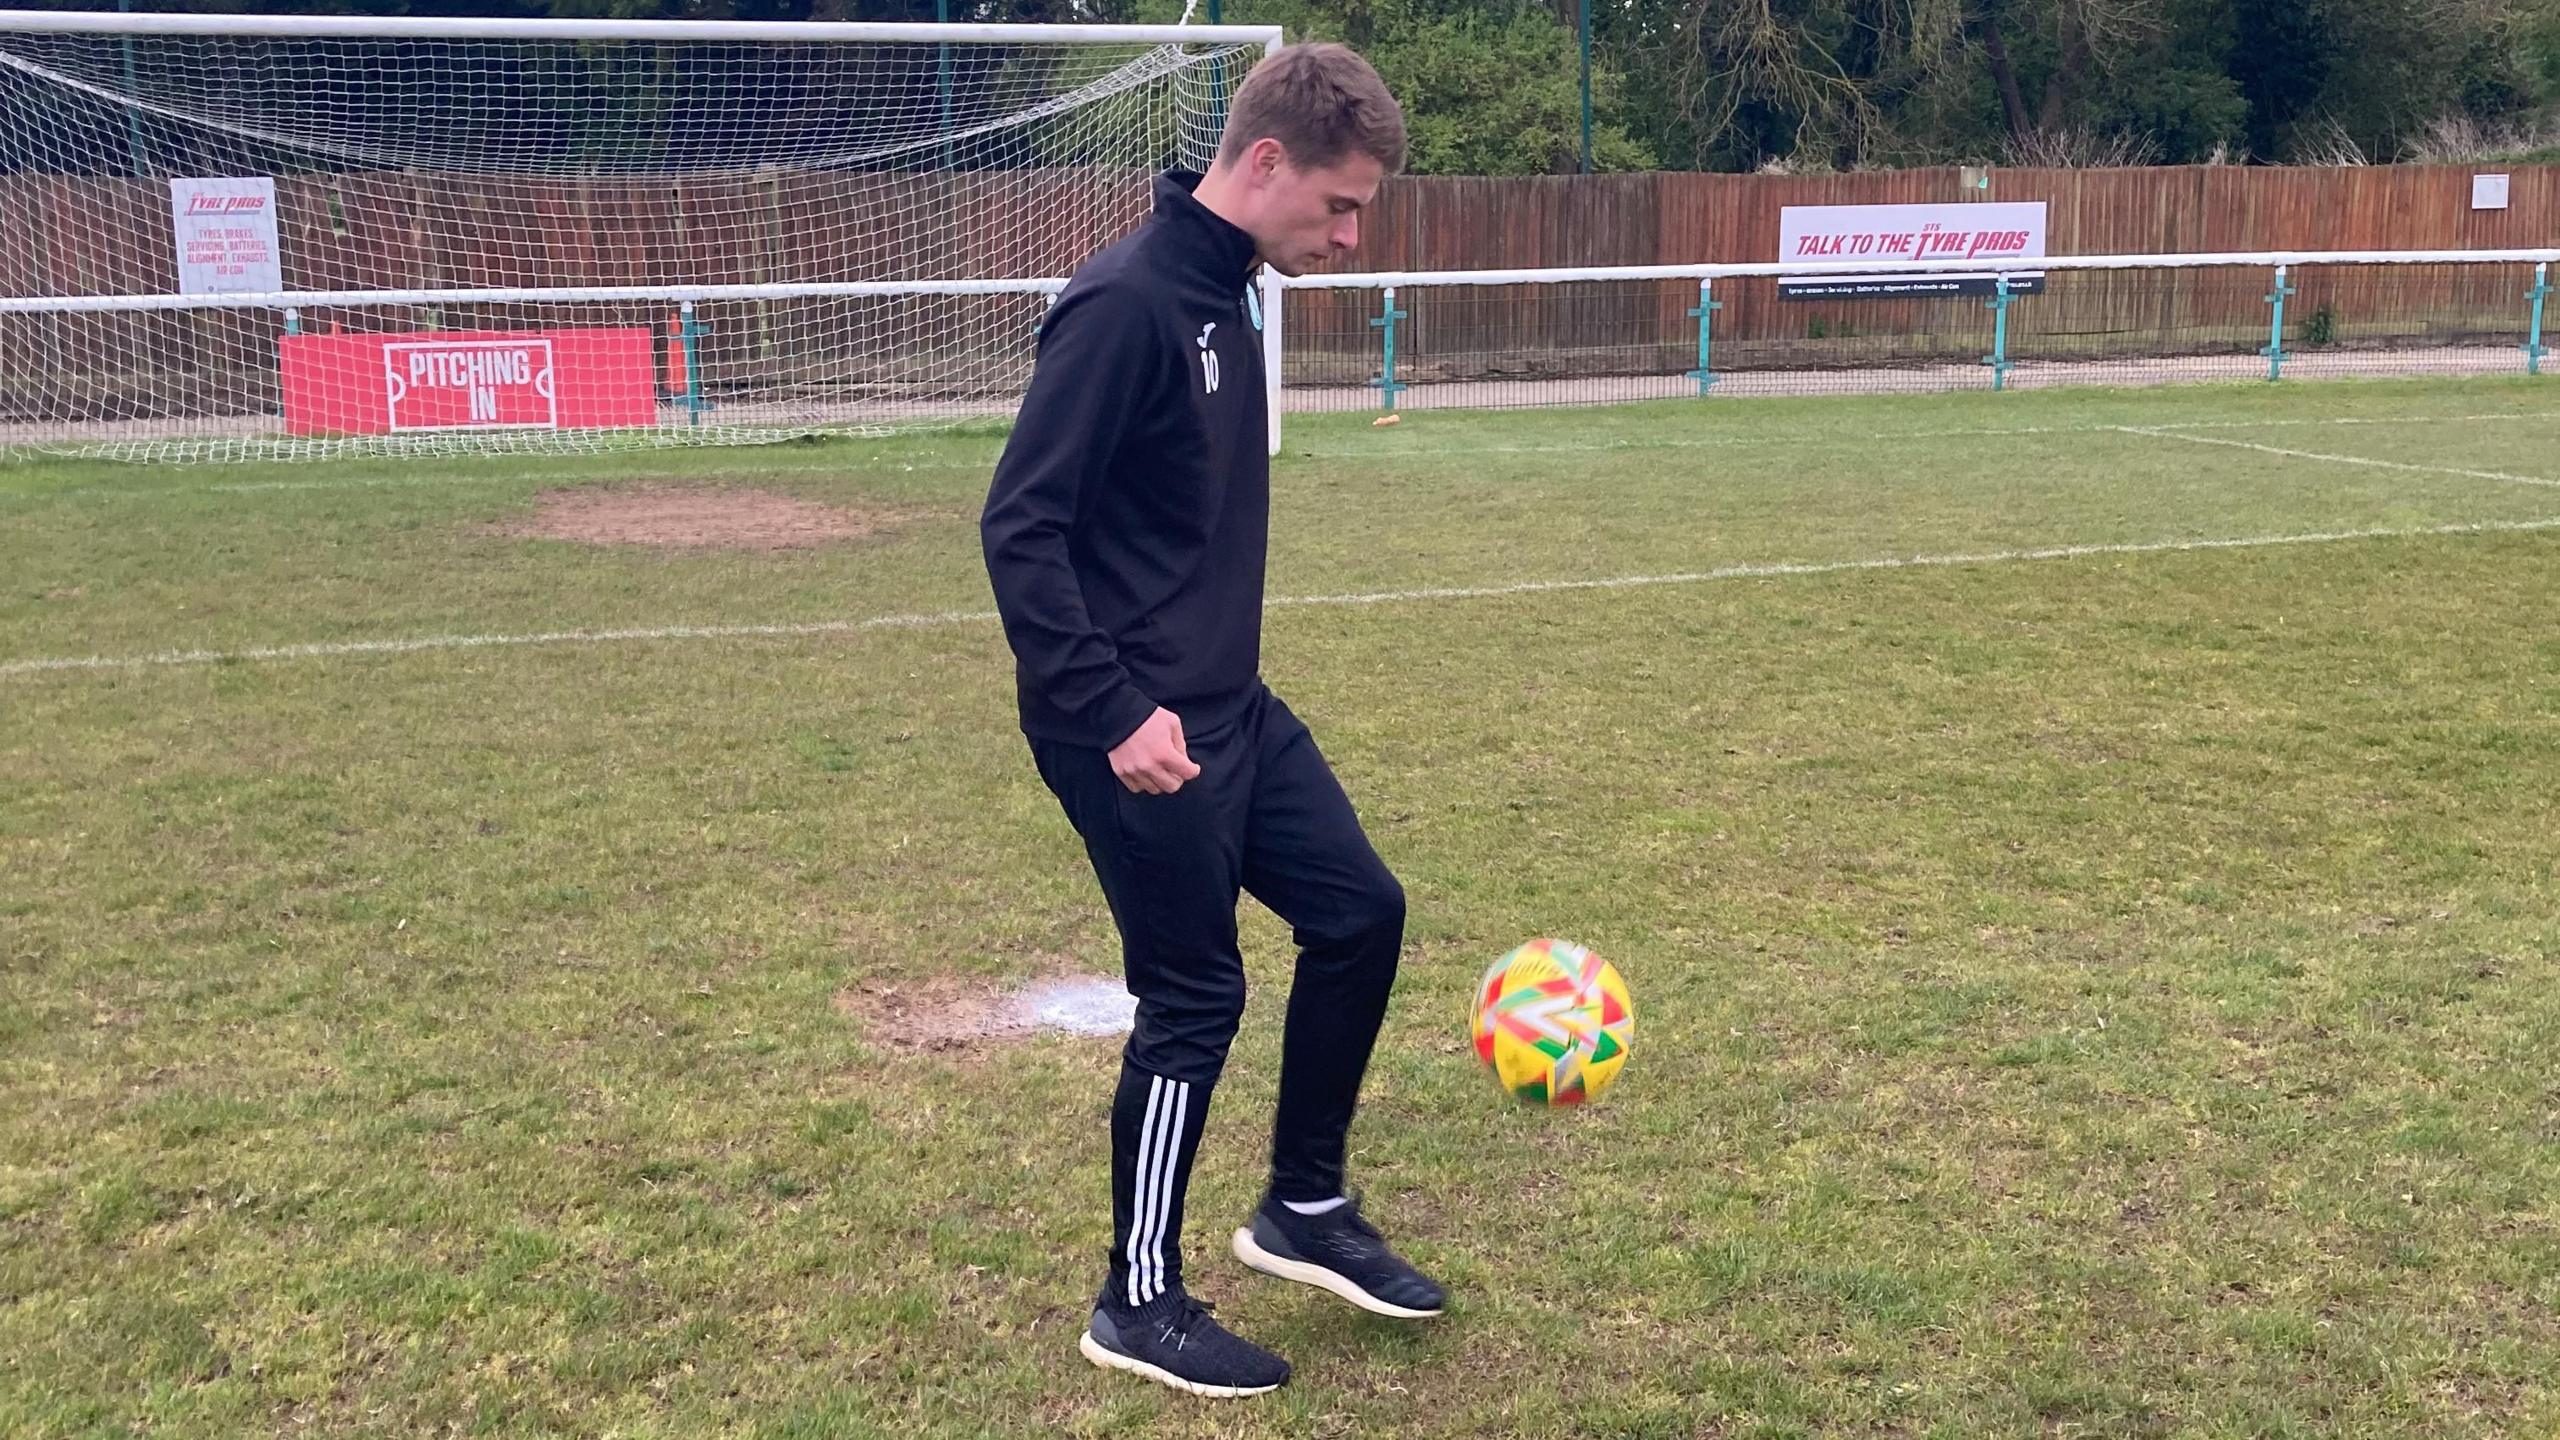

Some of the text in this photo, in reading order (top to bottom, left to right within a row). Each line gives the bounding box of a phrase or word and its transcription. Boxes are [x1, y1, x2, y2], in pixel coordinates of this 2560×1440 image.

[1797, 230, 2030, 260] TALK TO THE TYRE PROS
[1923, 223, 1942, 232] STS
[409, 350, 532, 388] PITCHING
[1200, 349, 1220, 394] 10
[469, 385, 497, 421] IN
